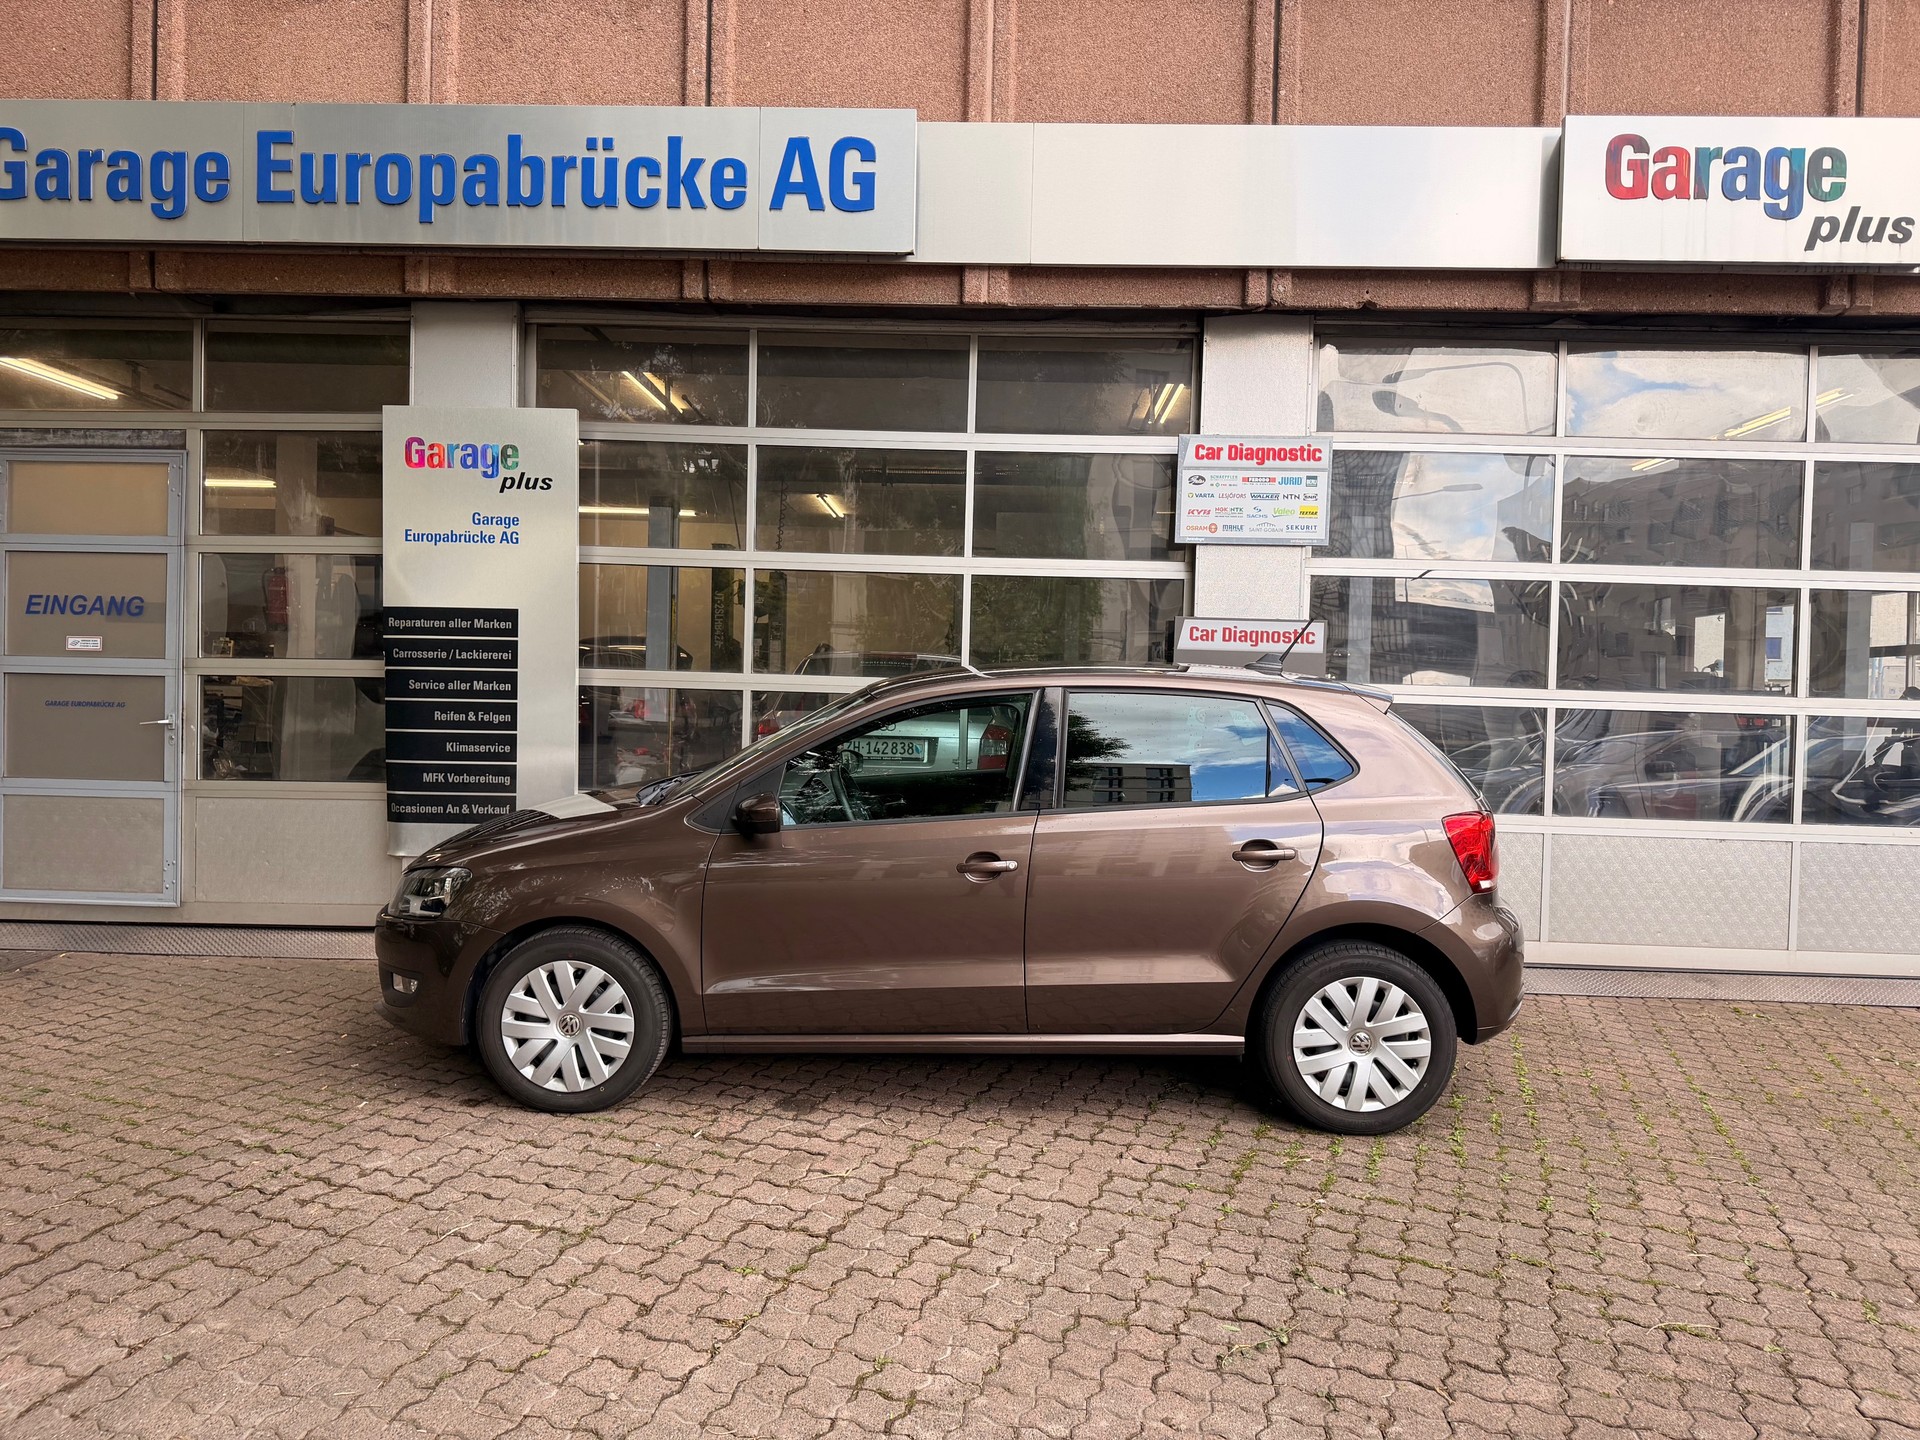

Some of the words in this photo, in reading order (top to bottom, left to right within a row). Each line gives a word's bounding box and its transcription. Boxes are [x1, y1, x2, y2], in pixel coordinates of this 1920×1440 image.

[0, 127, 231, 219] Garage
[256, 129, 748, 224] Europabrücke
[768, 135, 877, 213] AG
[1604, 133, 1847, 221] Garage
[1804, 206, 1916, 252] plus
[404, 436, 520, 479] Garage
[1194, 443, 1223, 461] Car
[1227, 443, 1322, 466] Diagnostic
[499, 472, 553, 493] plus
[1278, 476, 1302, 486] JURID
[472, 512, 520, 529] Garage
[404, 529, 496, 546] Europabrücke
[499, 531, 520, 545] AG
[25, 594, 145, 617] EINGANG
[388, 617, 446, 630] Reparaturen
[448, 618, 472, 629] aller
[474, 619, 512, 630] Marken
[1189, 626, 1218, 642] Car
[1221, 625, 1316, 647] Diagnostic
[392, 648, 447, 660] Carrosserie
[455, 649, 512, 660] Lackiererei
[408, 679, 445, 690] Service
[447, 680, 471, 690] aller
[473, 680, 512, 691] Marken
[71, 700, 115, 708] EUROPABRÜCKE
[434, 710, 466, 722] Reifen
[467, 711, 476, 721] &
[478, 711, 511, 724] Felgen
[446, 742, 511, 753] Klimaservice
[422, 772, 445, 783] MFK
[447, 773, 511, 785] Vorbereitung
[391, 802, 444, 814] Occasionen
[446, 803, 460, 814] An
[461, 804, 470, 814] &
[472, 804, 510, 815] Verkauf
